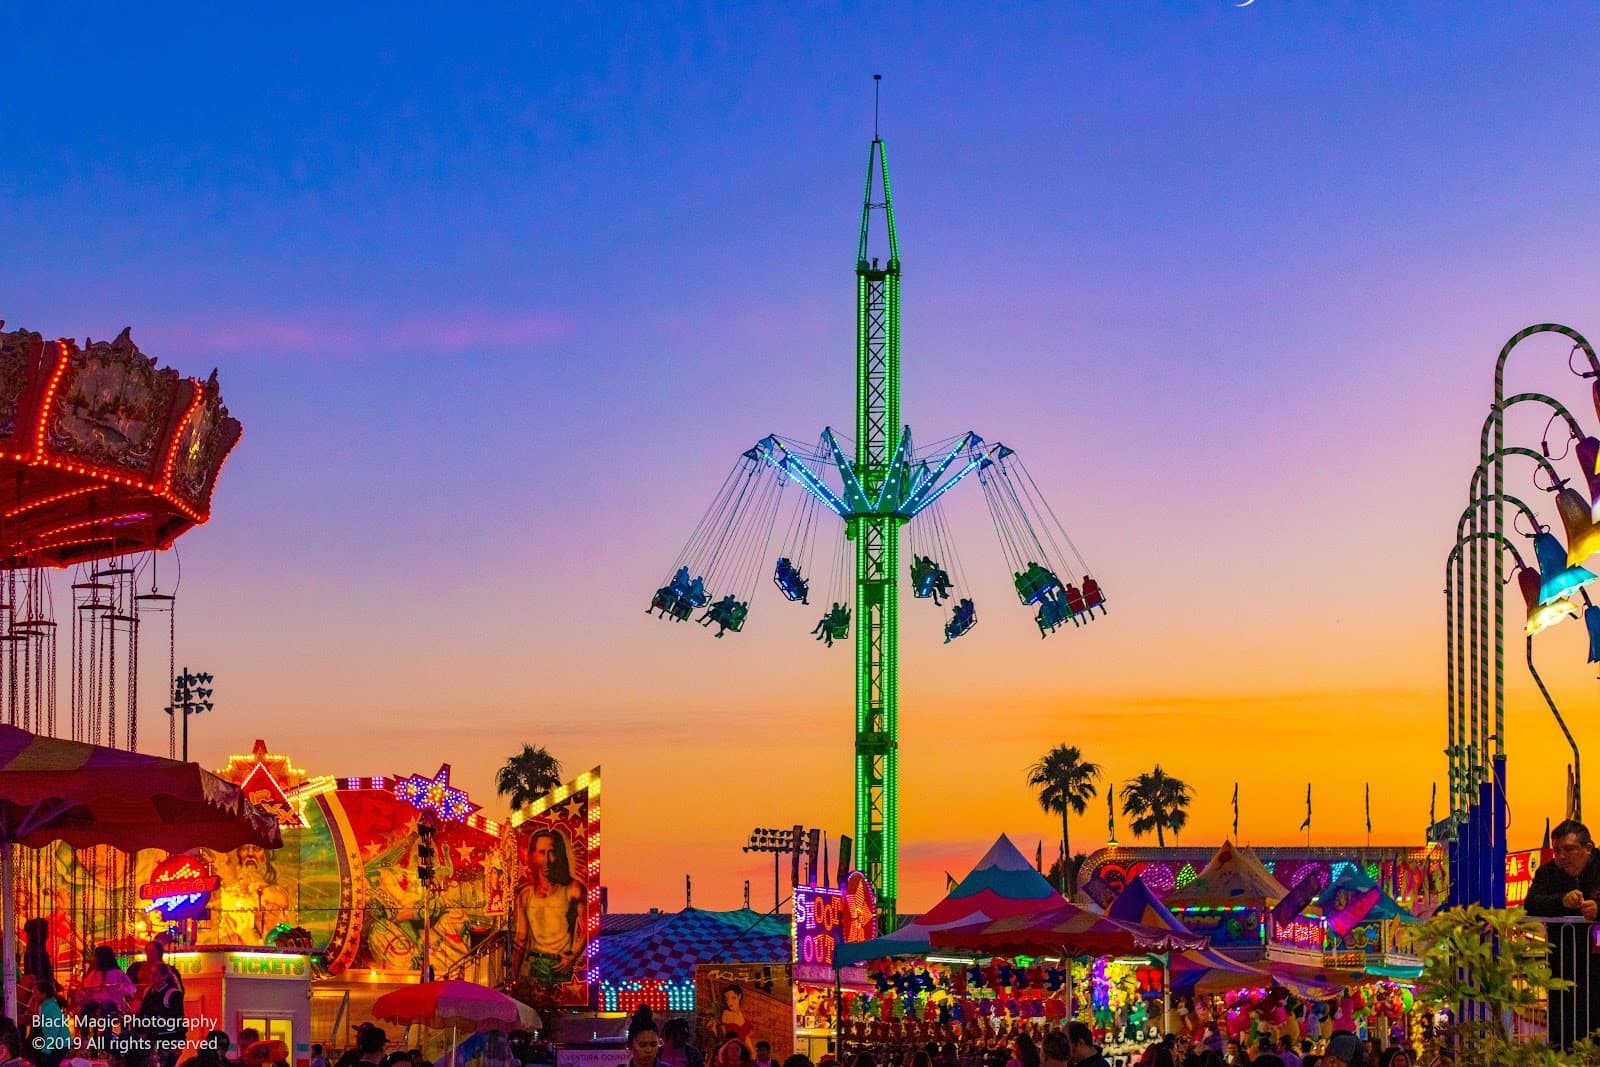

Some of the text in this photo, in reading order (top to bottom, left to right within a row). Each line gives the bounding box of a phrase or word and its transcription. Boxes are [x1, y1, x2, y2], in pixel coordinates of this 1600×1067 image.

[796, 893, 842, 932] SHOOT
[803, 933, 835, 964] OUT
[231, 957, 305, 975] TICKETS
